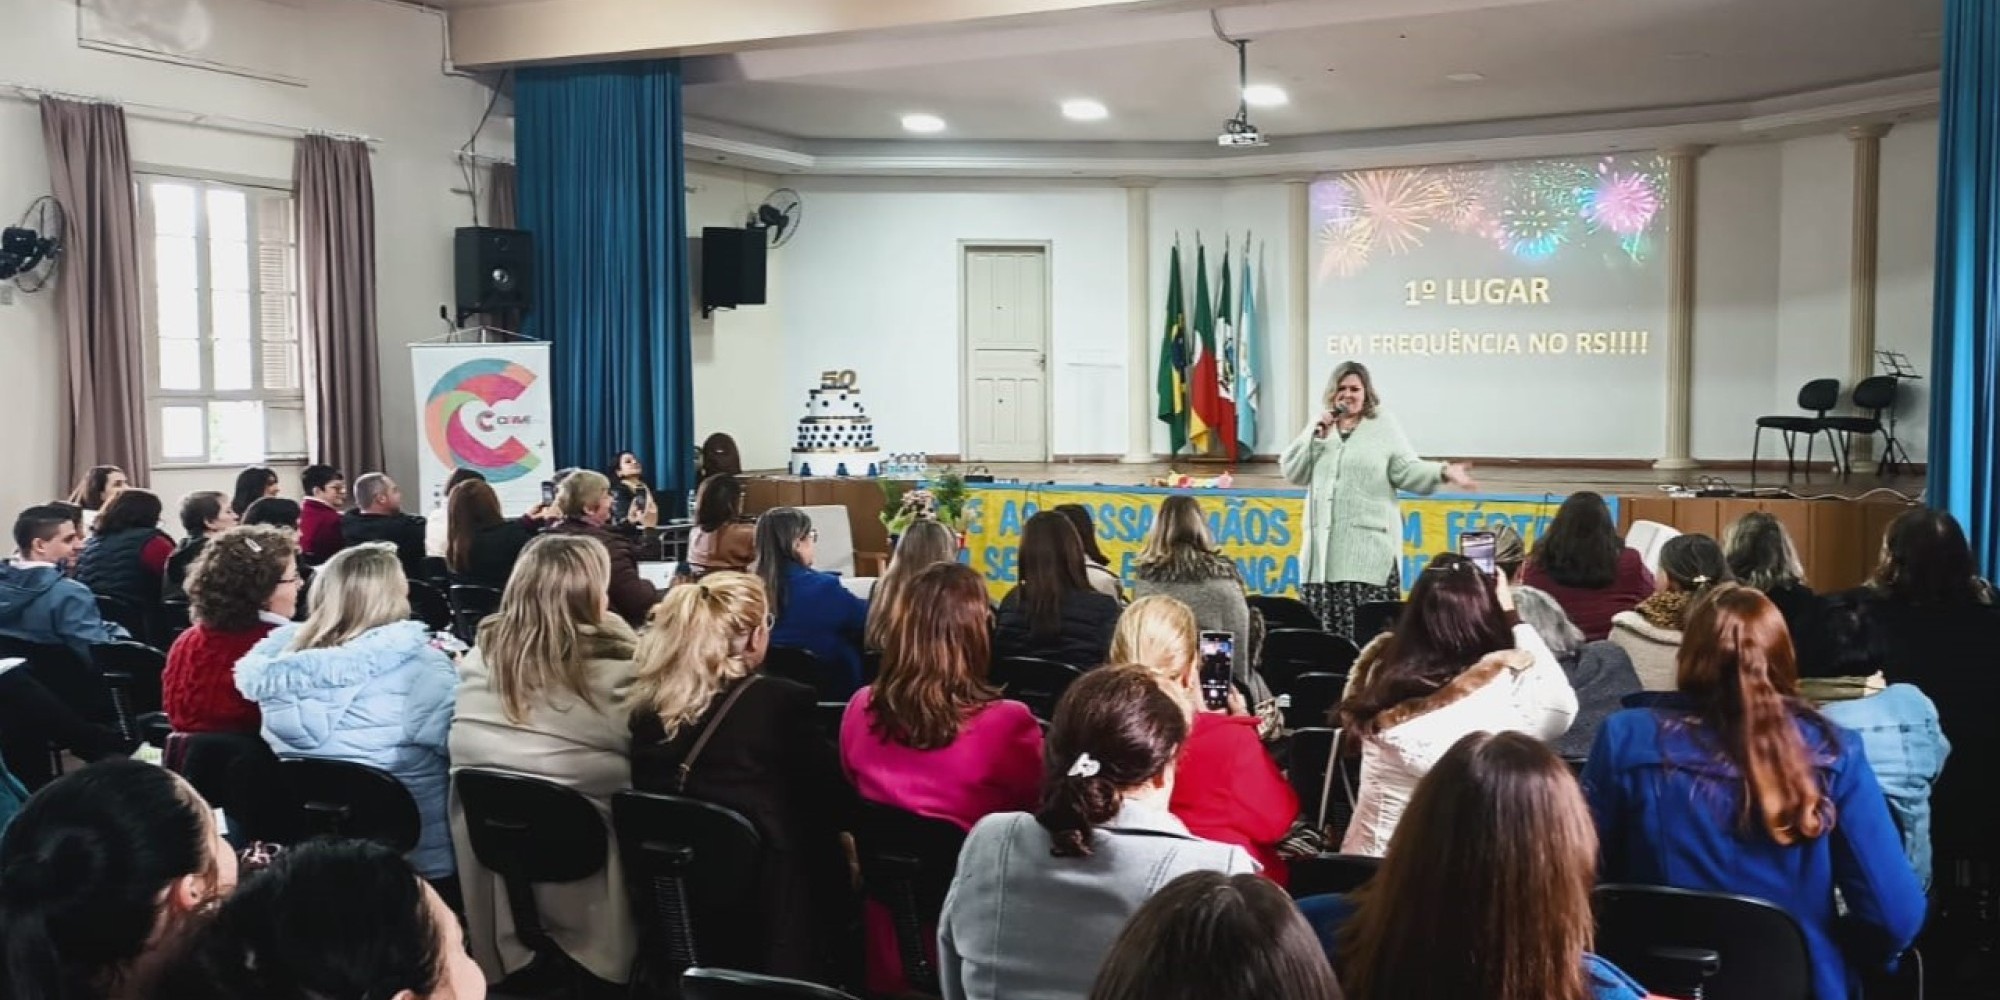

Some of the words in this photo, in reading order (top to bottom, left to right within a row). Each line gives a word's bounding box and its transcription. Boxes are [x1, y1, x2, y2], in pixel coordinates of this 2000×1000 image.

[1404, 279, 1437, 306] 1º
[1446, 277, 1550, 305] LUGAR
[1327, 333, 1362, 354] EM
[1369, 328, 1521, 357] FREQUÊNCIA
[1529, 333, 1568, 354] NO
[1576, 331, 1649, 355] RS!!!!
[821, 369, 857, 389] 50
